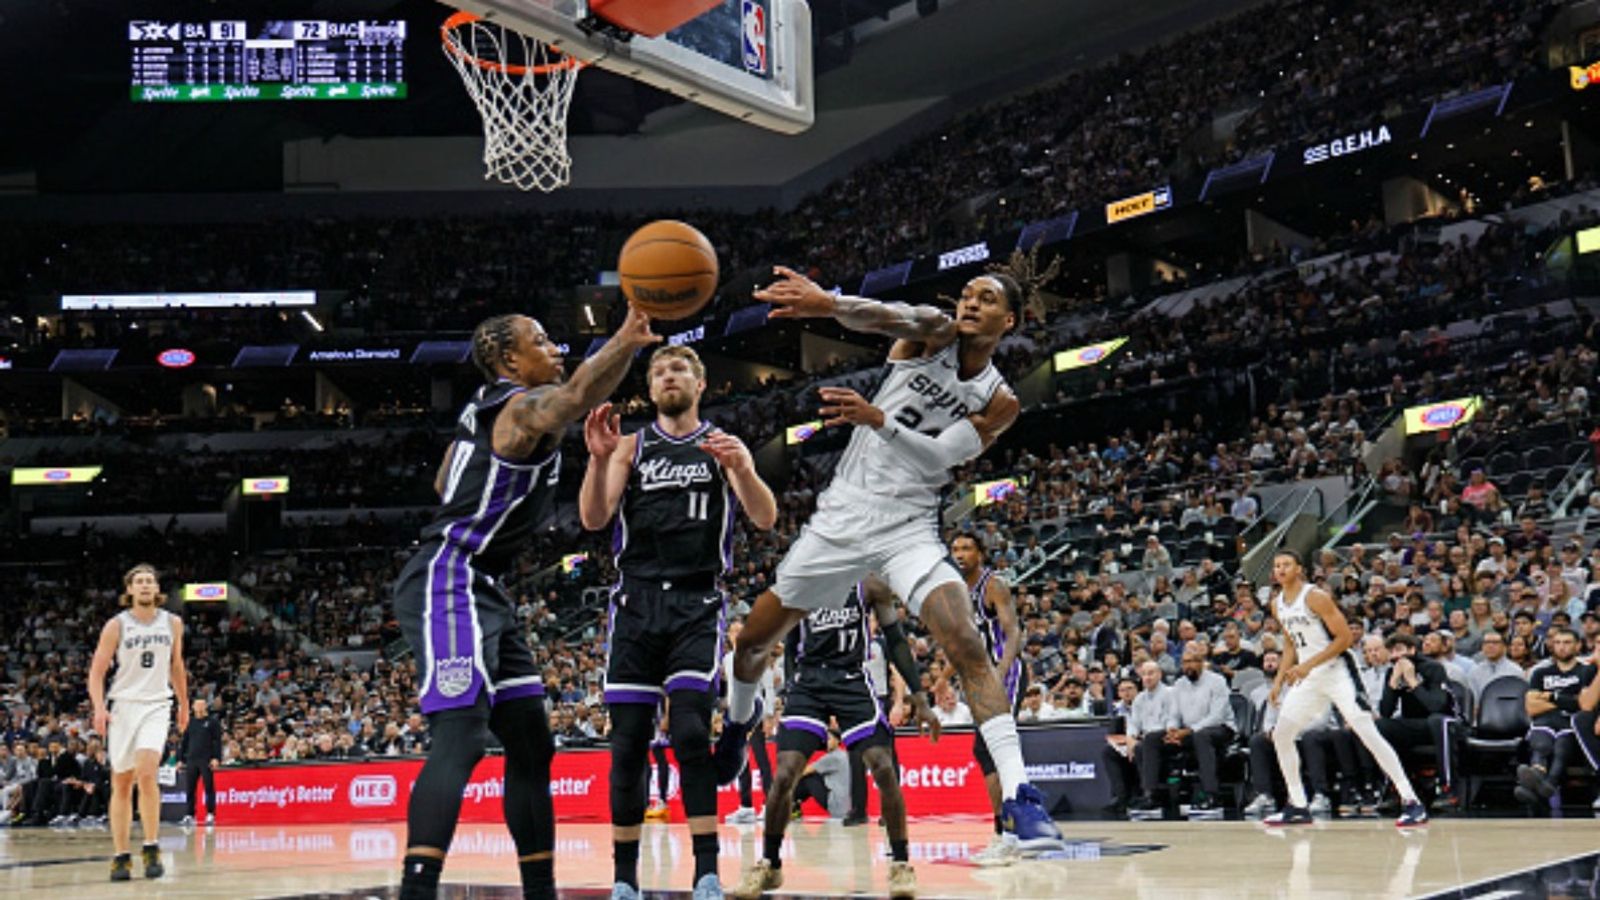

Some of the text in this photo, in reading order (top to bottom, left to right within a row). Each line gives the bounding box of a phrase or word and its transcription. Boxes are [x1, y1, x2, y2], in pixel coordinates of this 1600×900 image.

[221, 22, 236, 39] 91
[301, 22, 320, 38] 72
[327, 22, 358, 37] SAC
[143, 85, 179, 101] Sprite
[280, 85, 317, 100] Sprite
[361, 85, 397, 99] Sprite
[908, 373, 968, 421] SPUR
[638, 457, 713, 491] Kings
[687, 491, 709, 520] 11
[838, 628, 858, 652] 17
[140, 650, 154, 669] 8
[229, 783, 295, 808] Everything's
[297, 784, 335, 803] Better
[550, 776, 591, 797] etter
